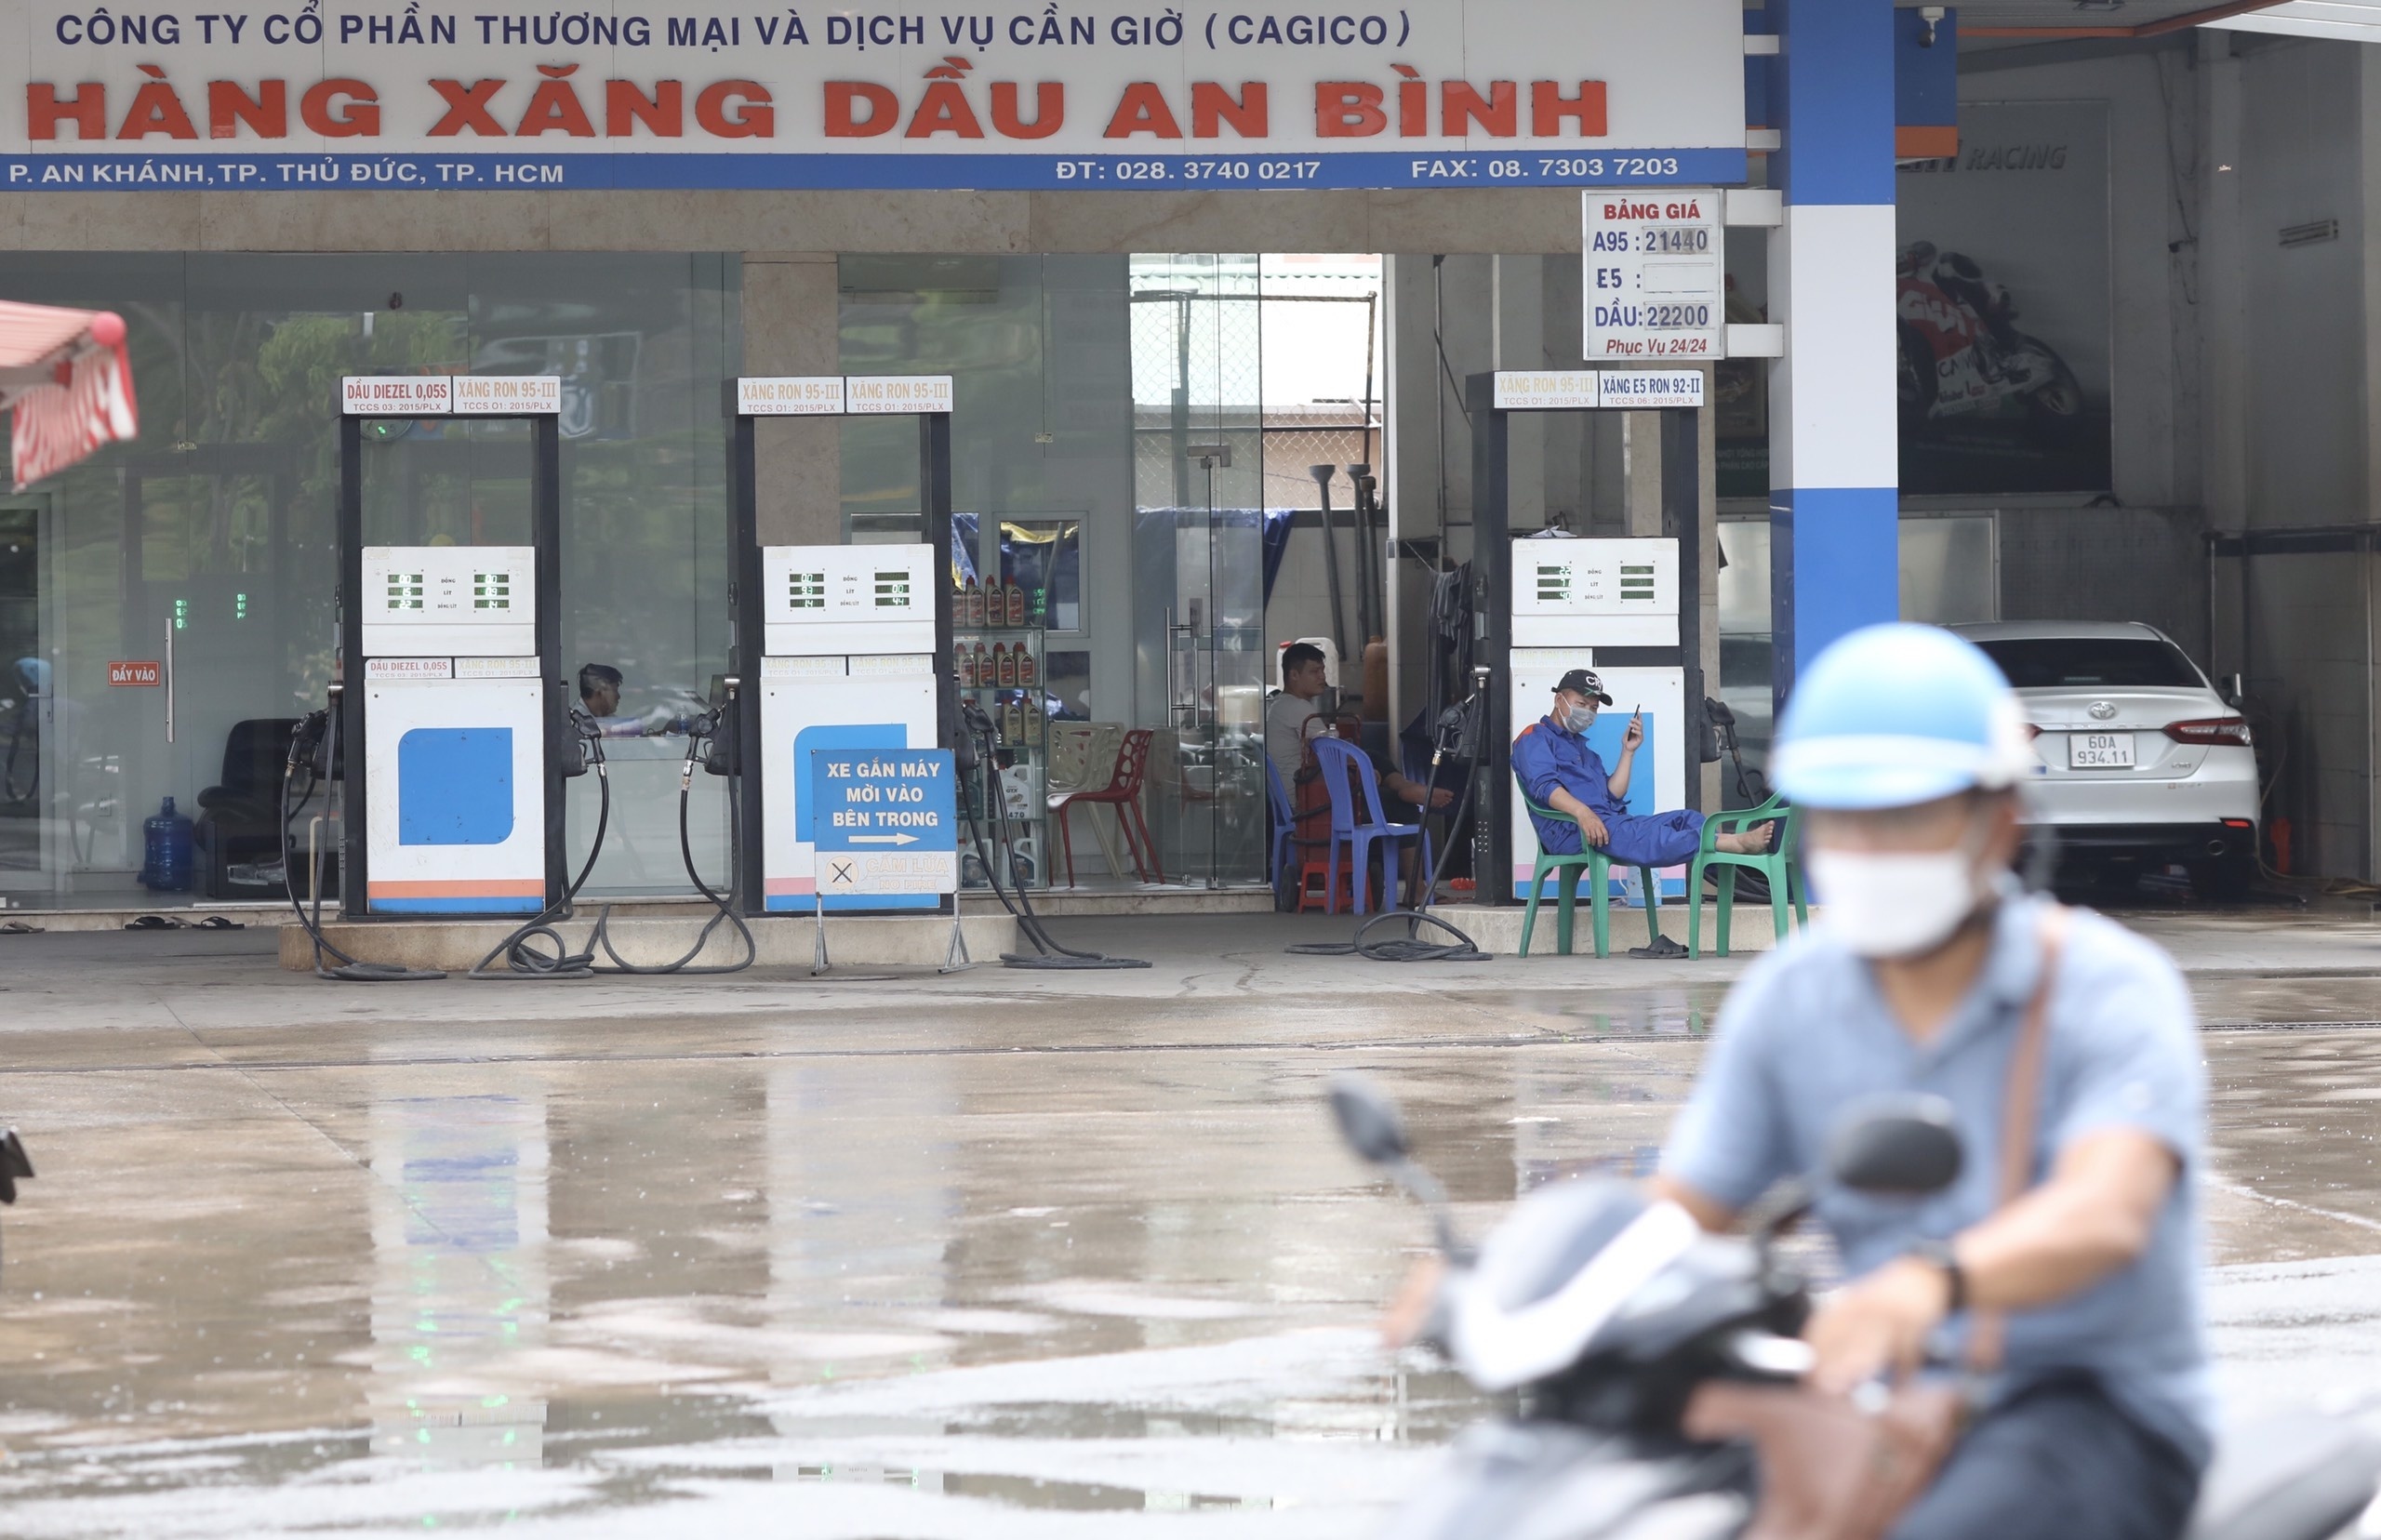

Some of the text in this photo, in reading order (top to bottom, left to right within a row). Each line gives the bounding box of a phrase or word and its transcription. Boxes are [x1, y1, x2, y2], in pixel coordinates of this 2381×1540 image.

[57, 7, 180, 45] CÔNG
[195, 15, 247, 44] TY
[264, 0, 322, 44] CỔ
[340, 2, 455, 44] PHẦN
[476, 12, 649, 46] THƯƠNG
[669, 18, 738, 52] MẠI
[754, 9, 809, 45] VÀ
[828, 16, 924, 50] DỊCH
[942, 17, 991, 51] VỤ
[1009, 3, 1094, 45] CẦN
[1111, 8, 1182, 46] GIỜ
[28, 59, 1607, 139] HÀNG XĂNG DẦU AN BÌNH
[1965, 145, 2068, 170] RACING
[10, 166, 32, 182] P.
[42, 166, 83, 182] AN
[277, 157, 339, 180] THỦ
[351, 162, 425, 183] ĐỨC,
[436, 165, 483, 181] TP.
[496, 165, 562, 182] HCM
[1057, 162, 1320, 179] ĐT: 028. 3740 0217
[1413, 158, 1678, 178] FAX: 08. 7303 7203
[1603, 198, 1701, 220] BẢNG GIÁ
[1645, 230, 1708, 251] 21440
[1647, 305, 1709, 326] 22200
[1606, 339, 1708, 356] Phục Vụ 24/24
[347, 378, 446, 401] DẦU DIEZEL 0,05S
[459, 378, 556, 398] XĂNG RON 95-III
[743, 380, 840, 401] XĂNG RON 95-III
[852, 379, 949, 399] XĂNG RON 95-III
[1499, 374, 1594, 393] XĂNG RON 95-III
[1603, 376, 1700, 393] XĂNG E5 RON 92-II
[353, 404, 379, 412] TCCS
[399, 403, 441, 411] 2015/PLX
[463, 402, 489, 410] TCCS
[510, 402, 552, 410] 2015/PLX
[747, 404, 773, 413] TCCS
[793, 404, 835, 412] 2015/PLX
[856, 403, 882, 412] TCCS
[902, 402, 944, 411] 2015/PLX
[1503, 397, 1528, 405] TCCS
[1549, 397, 1590, 405] 2015/PLX
[1654, 396, 1694, 405] 2015/PLX
[391, 662, 420, 670] DIEZEL
[423, 661, 447, 671] 0,05S
[487, 659, 506, 669] RON
[793, 659, 811, 669] RON
[881, 657, 898, 668] RON
[112, 664, 155, 682] ĐẨY VÀO
[2088, 736, 2116, 749] 60A
[2078, 750, 2128, 764] 934.11
[827, 757, 940, 778] XE GẮN MÁY
[846, 784, 924, 803] MỜI VÀO
[832, 809, 938, 827] BÊN TRONG
[866, 854, 906, 873] CẤM
[879, 879, 938, 890] NO FIRE
